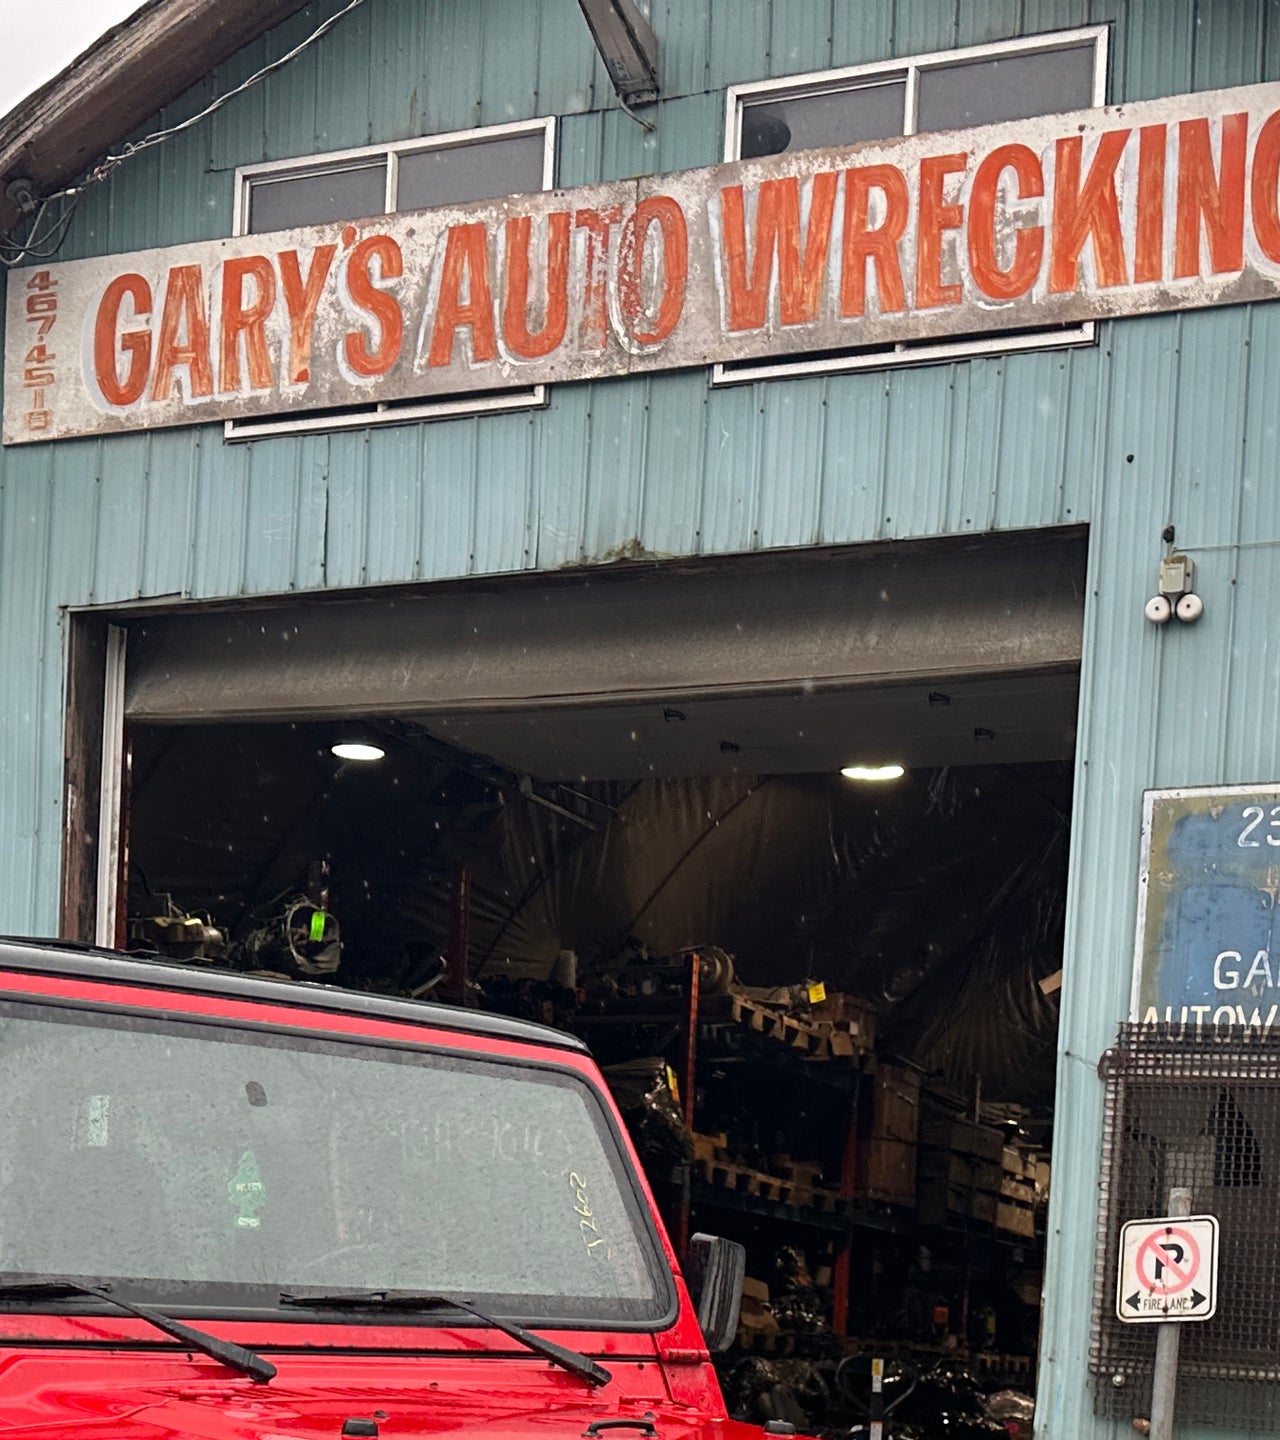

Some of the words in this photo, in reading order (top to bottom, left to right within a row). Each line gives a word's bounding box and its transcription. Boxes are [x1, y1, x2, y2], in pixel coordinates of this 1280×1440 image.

[93, 225, 404, 408] GARY'S
[428, 195, 690, 369] AUTO
[1143, 1298, 1162, 1311] FIRE
